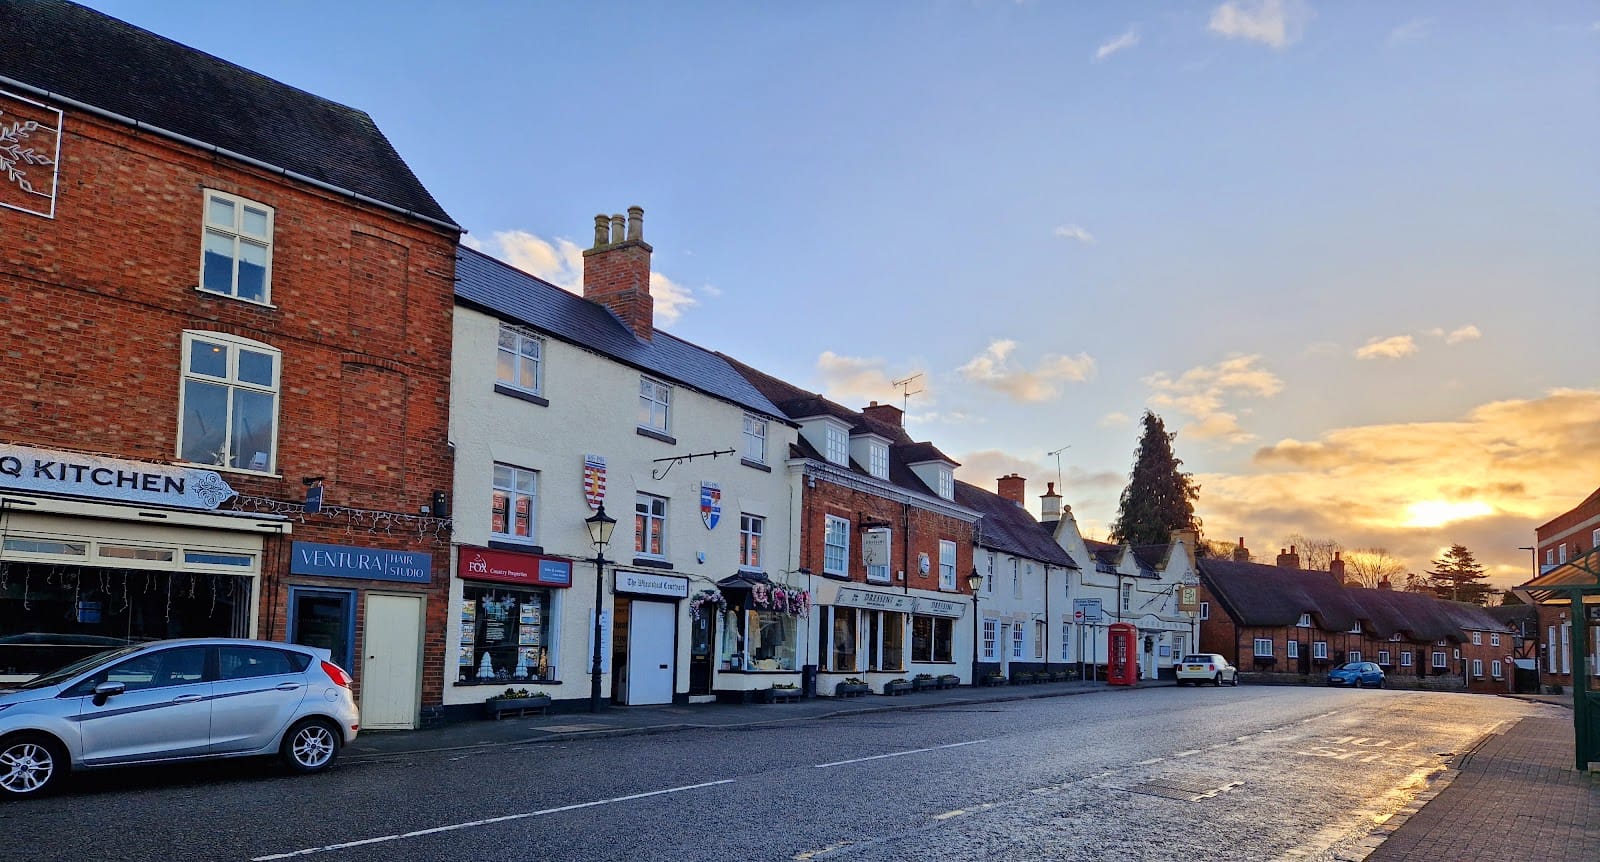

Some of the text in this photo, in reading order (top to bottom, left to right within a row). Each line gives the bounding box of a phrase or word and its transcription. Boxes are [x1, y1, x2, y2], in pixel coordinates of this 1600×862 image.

[33, 459, 185, 494] KITCHEN
[302, 549, 382, 571] VENTURA
[390, 554, 413, 565] HAIR
[390, 567, 424, 578] STUDIO
[469, 561, 487, 573] FOX
[490, 568, 528, 578] Country Properties
